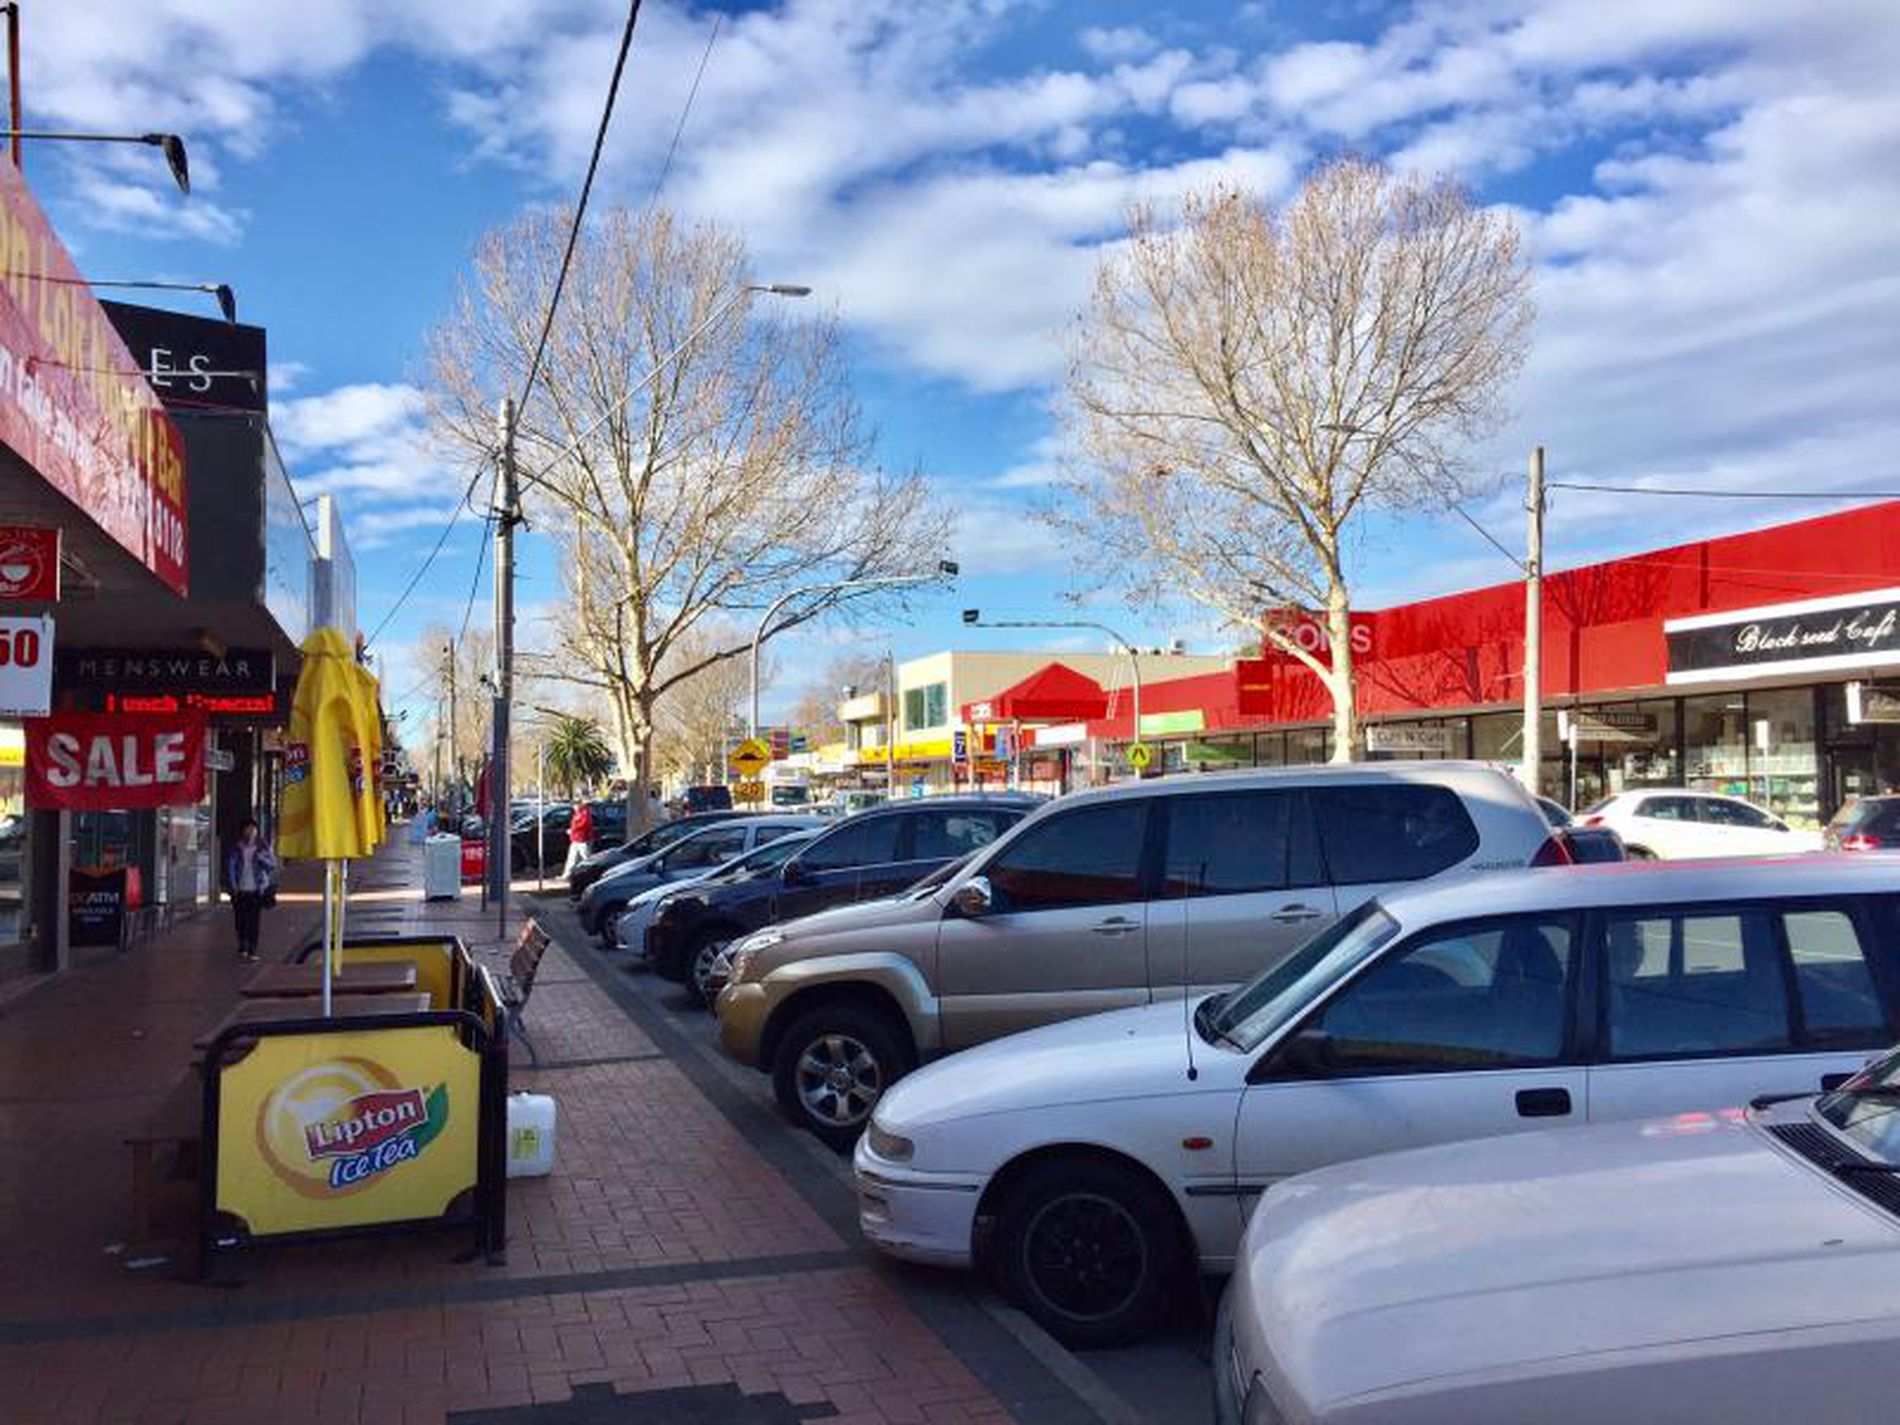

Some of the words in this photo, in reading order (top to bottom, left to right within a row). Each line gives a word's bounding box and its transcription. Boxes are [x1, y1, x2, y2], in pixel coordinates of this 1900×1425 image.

[1735, 624, 1798, 651] Black
[1801, 618, 1842, 645] seed
[79, 658, 250, 677] MENSWEAR
[47, 732, 186, 787] SALE
[315, 1101, 416, 1148] Lipton
[331, 1156, 371, 1186] Ice
[373, 1137, 416, 1167] Tea
